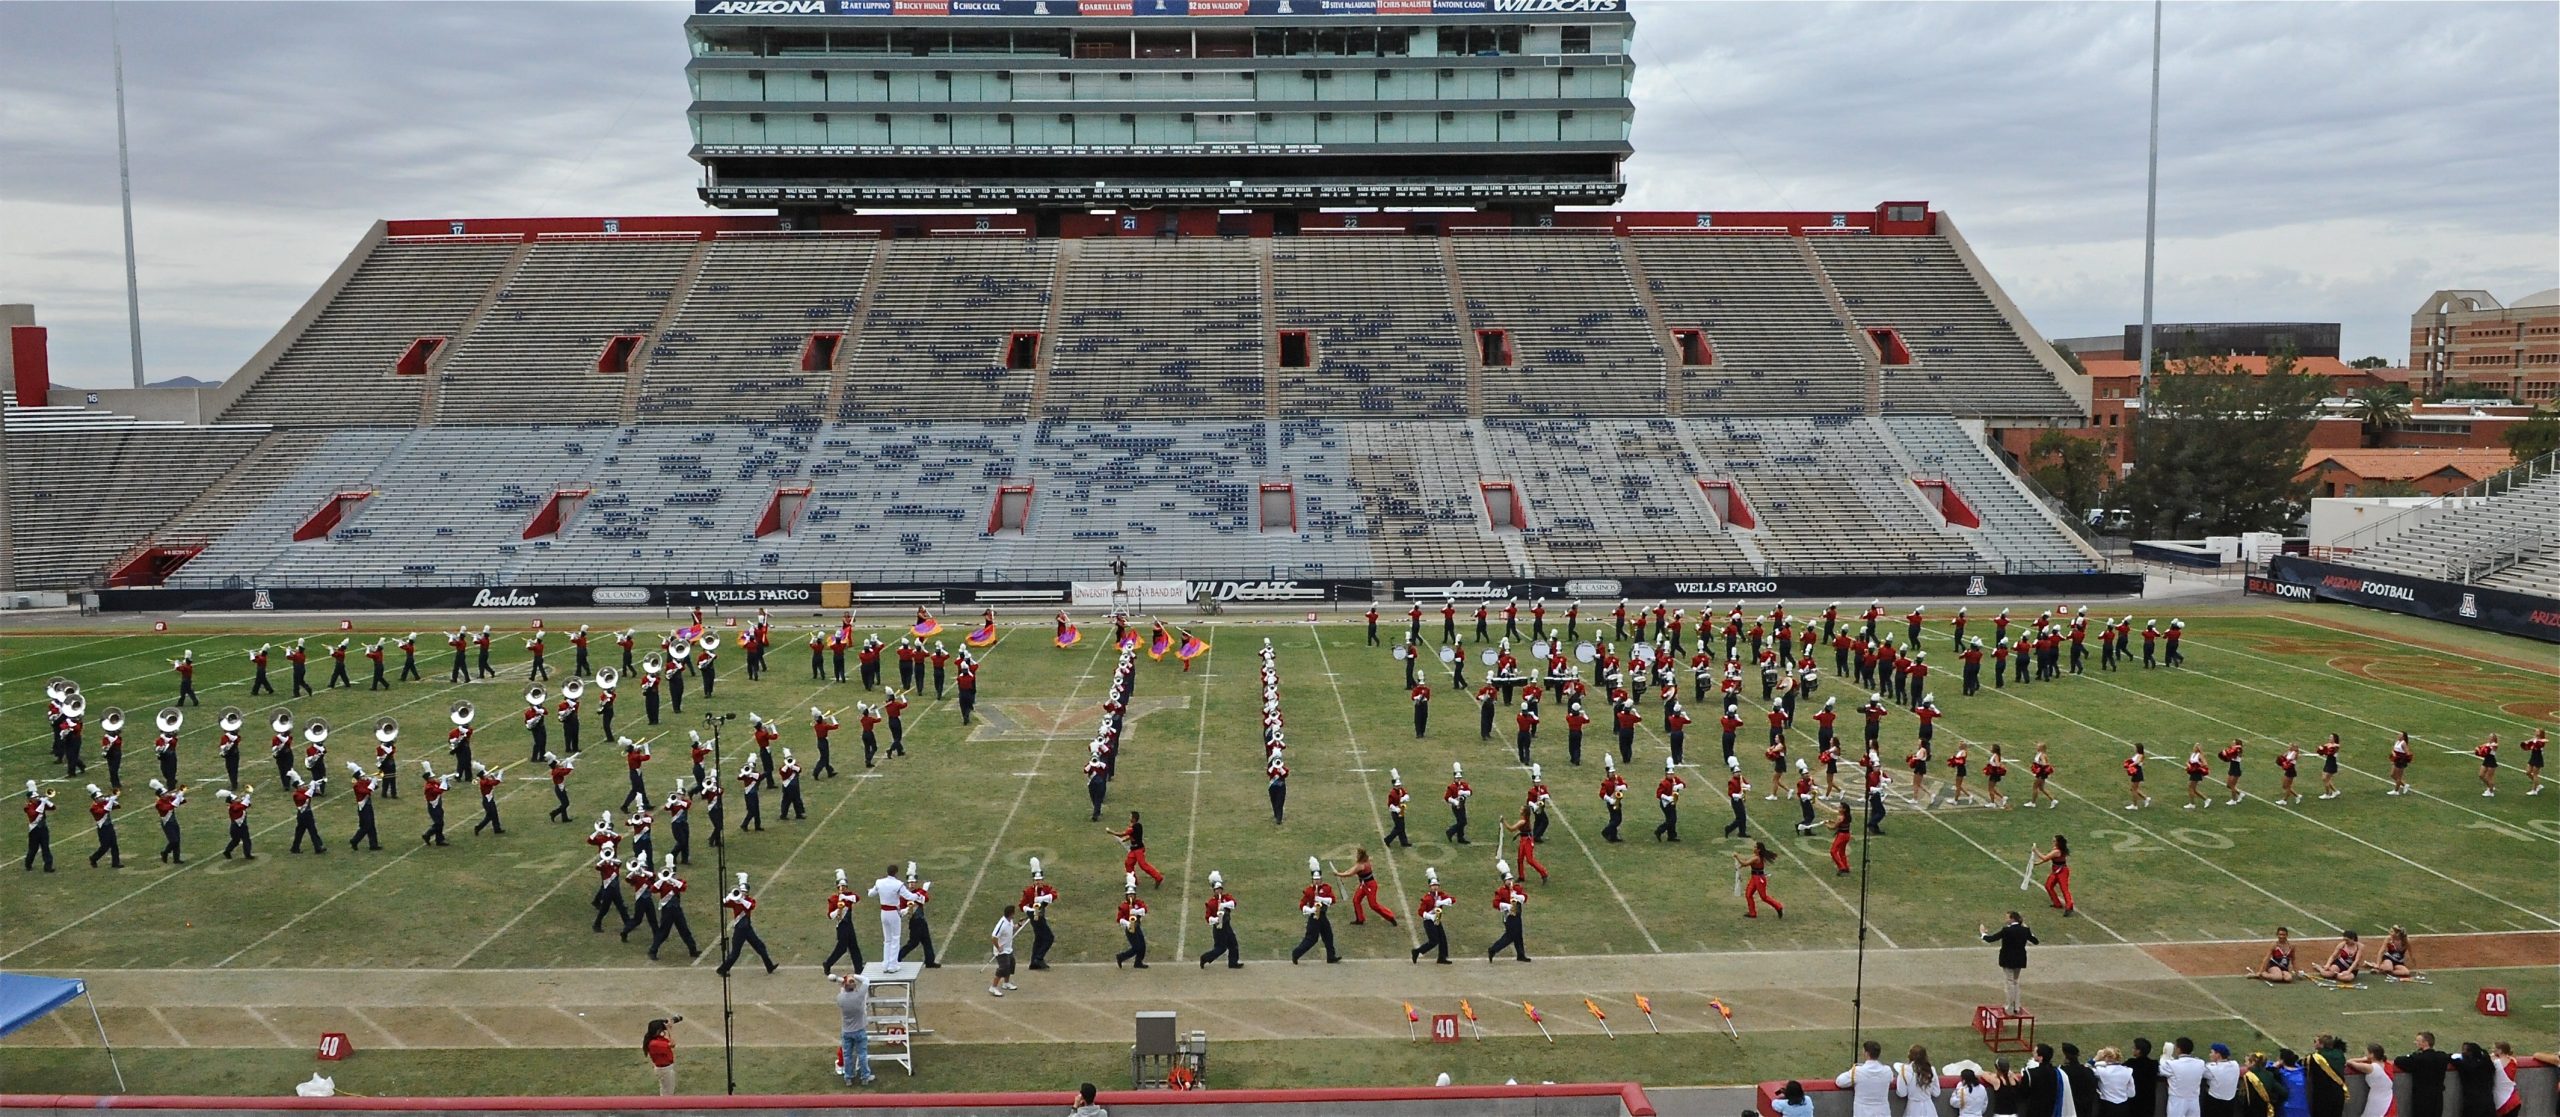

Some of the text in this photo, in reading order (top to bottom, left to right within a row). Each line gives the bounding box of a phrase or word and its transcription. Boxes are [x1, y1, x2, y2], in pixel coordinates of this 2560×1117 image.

[708, 1, 826, 13] ARIZONA
[841, 1, 849, 10] 22
[1493, 0, 1618, 12] WILDCATS
[780, 222, 792, 231] 19
[976, 222, 989, 230] 20
[1124, 220, 1135, 229] 21
[1344, 219, 1357, 228] 22
[1540, 218, 1552, 227] 23
[1697, 219, 1710, 228] 24
[1832, 219, 1845, 228] 25
[452, 226, 464, 234] 17
[605, 224, 617, 233] 18
[87, 394, 97, 403] 16
[1674, 582, 1776, 592] WELLS FARGO
[1967, 576, 1987, 596] A
[472, 588, 538, 606] Bashas'
[704, 590, 809, 600] WELLS FARGO
[1074, 588, 1109, 597] UNIVERSITY
[1151, 587, 1168, 597] BAND
[1171, 587, 1184, 597] DAY
[252, 590, 273, 610] A
[2460, 594, 2478, 618] A
[2090, 828, 2236, 852] 20
[2486, 993, 2506, 1012] 20
[1436, 1019, 1454, 1038] 40
[320, 1037, 340, 1056] 40
